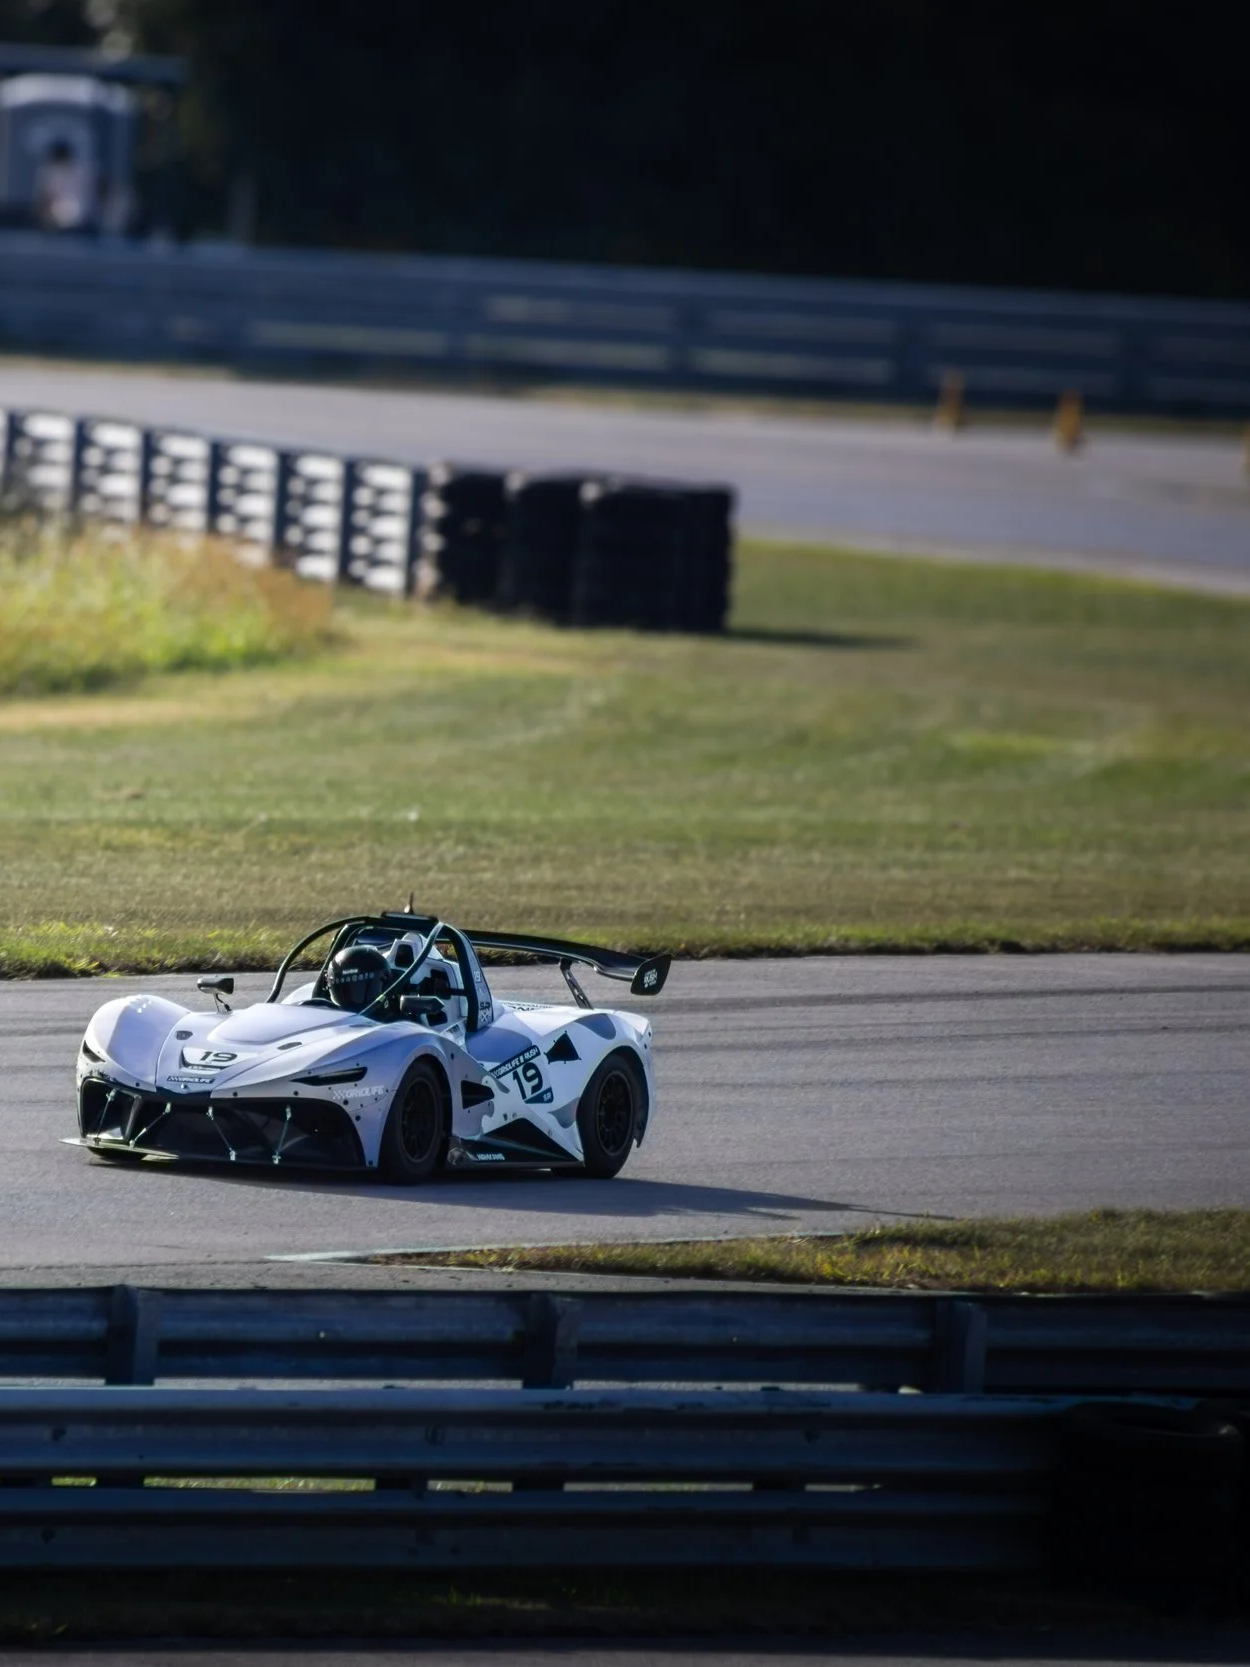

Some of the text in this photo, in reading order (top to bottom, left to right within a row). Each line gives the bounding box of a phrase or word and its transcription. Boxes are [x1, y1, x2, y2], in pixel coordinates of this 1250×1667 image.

[199, 1051, 238, 1062] 19
[524, 1046, 540, 1061] RUSH
[512, 1062, 544, 1101] 19
